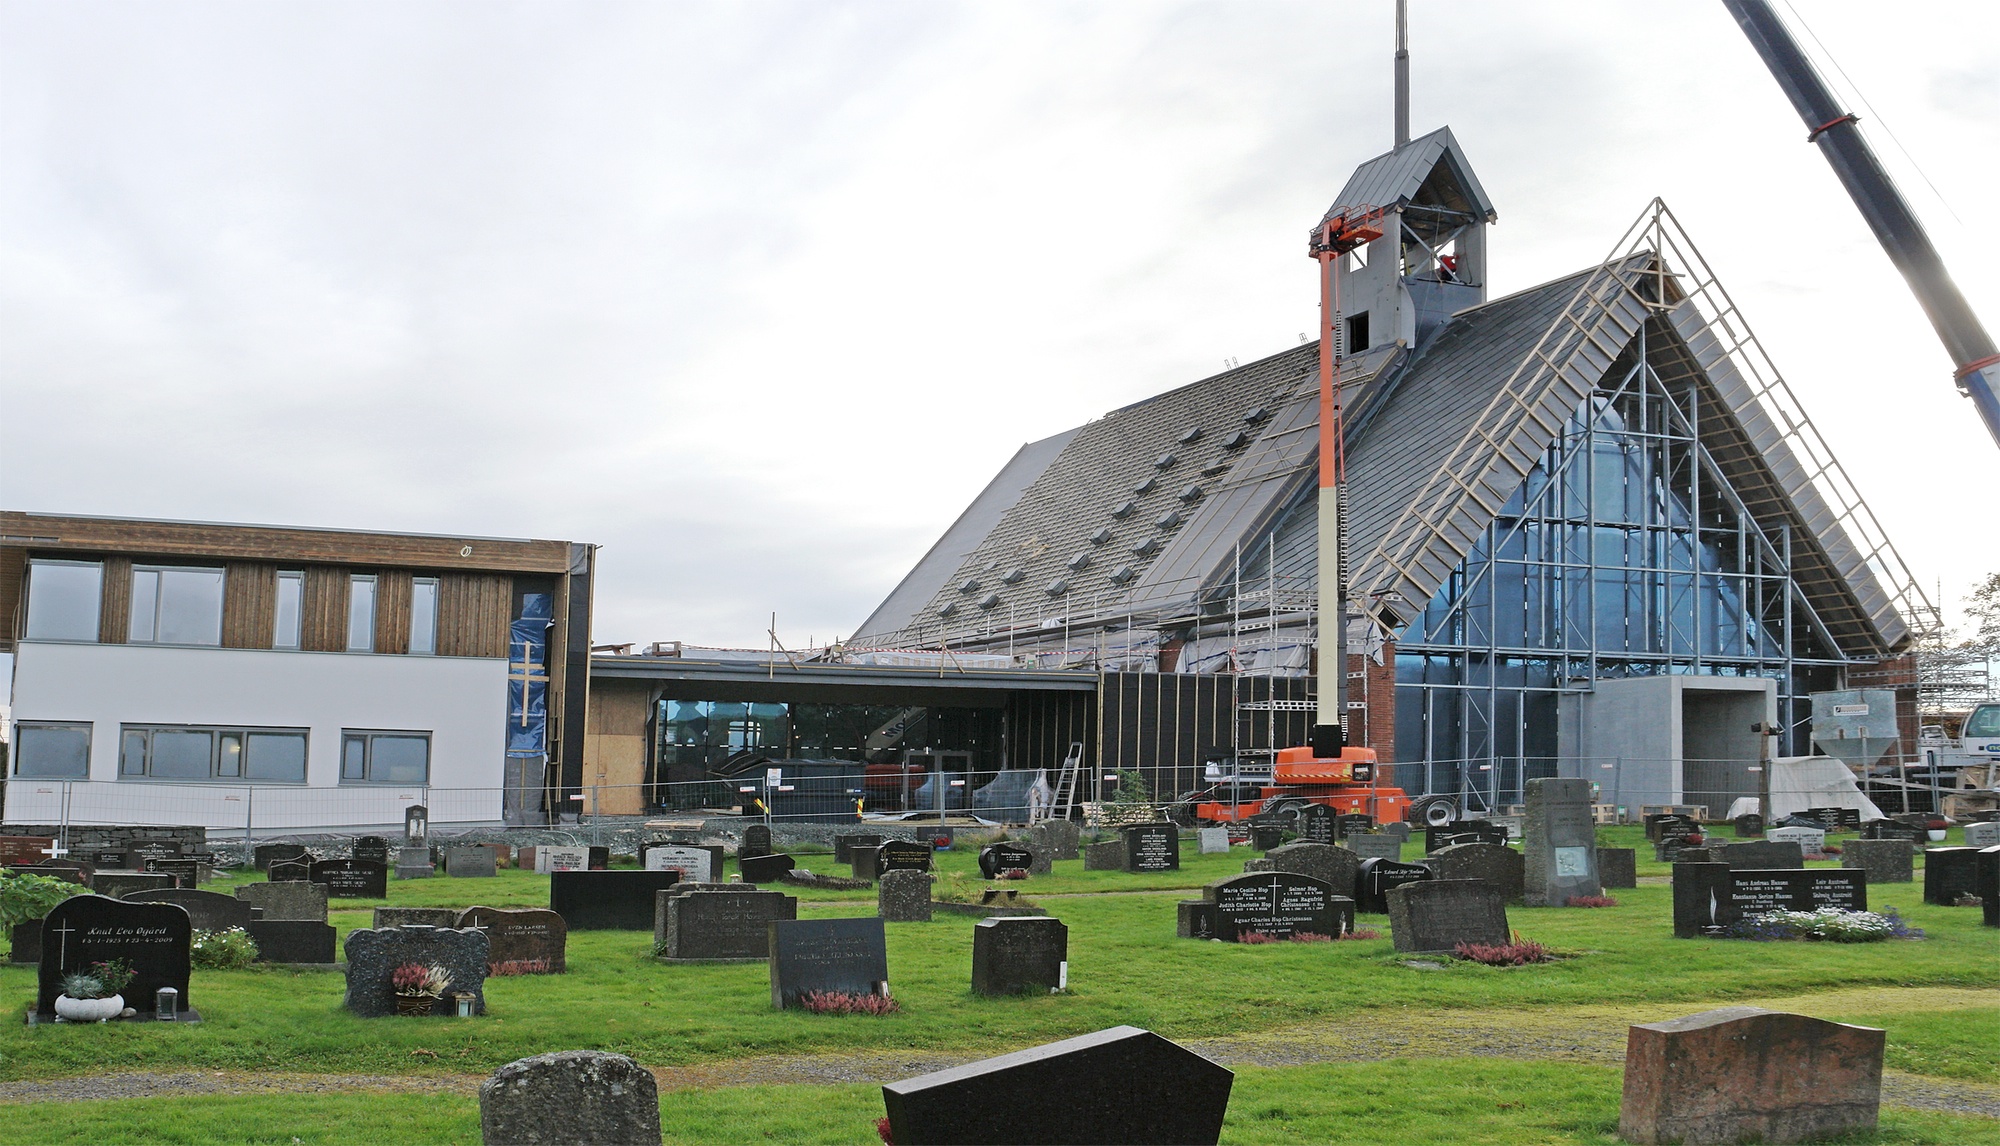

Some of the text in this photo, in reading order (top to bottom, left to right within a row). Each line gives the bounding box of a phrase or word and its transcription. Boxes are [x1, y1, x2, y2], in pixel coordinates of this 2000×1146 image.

[1307, 885, 1318, 893] Hop
[1260, 901, 1272, 909] Hop
[87, 926, 167, 936] Knut Leo Øgård
